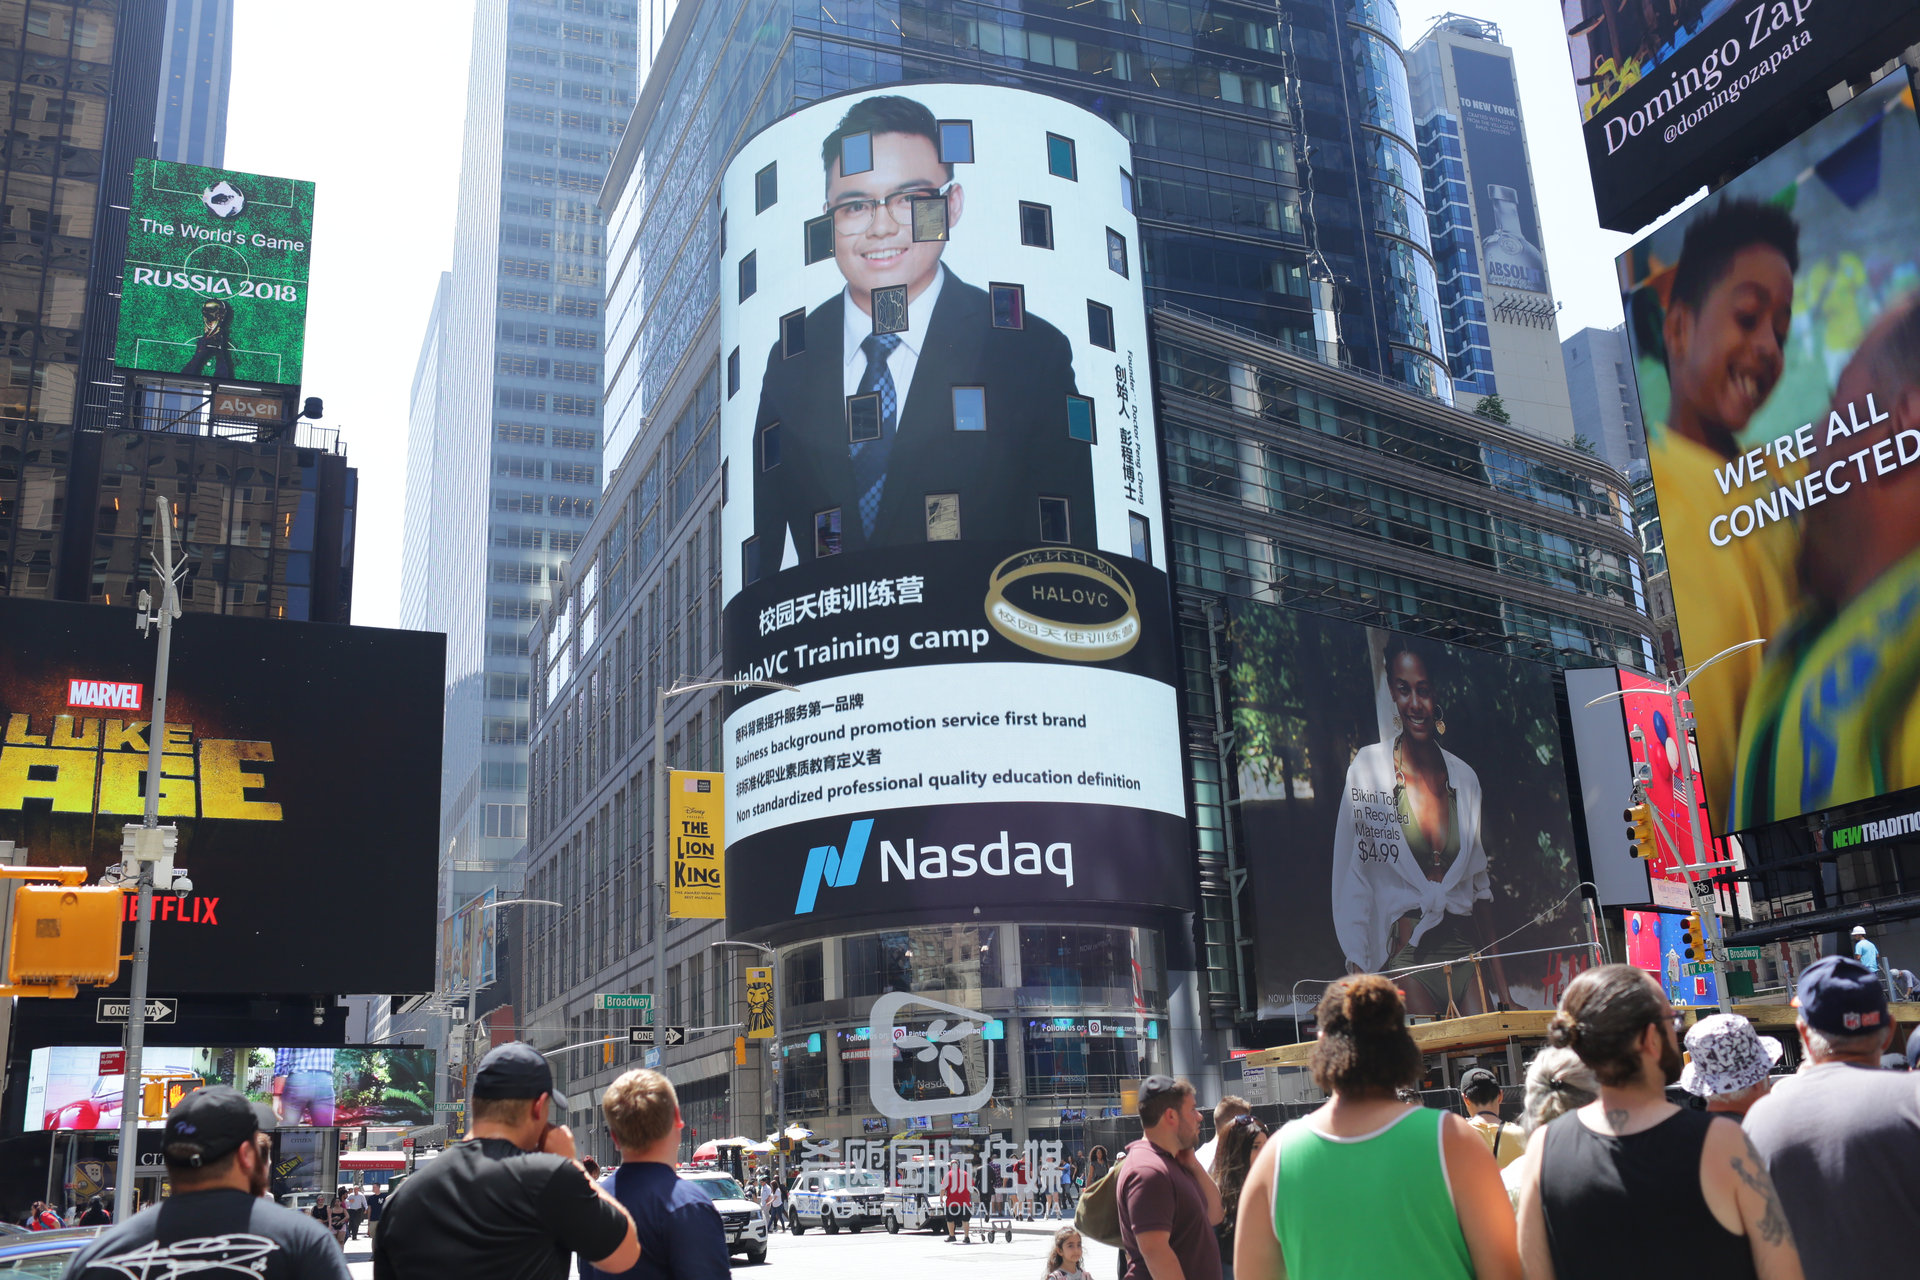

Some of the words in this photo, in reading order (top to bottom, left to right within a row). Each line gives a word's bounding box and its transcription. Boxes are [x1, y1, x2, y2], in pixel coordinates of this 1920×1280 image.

[1603, 38, 1740, 156] Domingo
[1664, 30, 1813, 143] @domingozapata
[1460, 97, 1471, 107] TO
[1473, 100, 1491, 112] NEW
[139, 218, 174, 235] The
[180, 223, 246, 245] World's
[251, 233, 305, 252] Game
[133, 267, 233, 295] RUSSIA
[238, 280, 297, 302] 2018
[1115, 364, 1131, 420] 创始人
[220, 398, 278, 417] Absen
[1131, 404, 1139, 441] Doctor
[1137, 472, 1145, 506] Cheng
[1713, 422, 1817, 495] WE'RE
[1826, 393, 1889, 447] ALL
[1709, 429, 1920, 547] CONNECTED
[759, 575, 925, 637] 校园天使训练营
[1032, 585, 1109, 607] HALOVC
[733, 650, 788, 695] HaloVC
[794, 631, 899, 669] Training
[909, 628, 989, 653] camp
[69, 681, 140, 708] MARVEL
[4, 713, 194, 753] LUKE
[735, 746, 769, 770] Business
[771, 724, 845, 754] background
[850, 715, 936, 741] promotion
[942, 712, 1000, 728] service
[1005, 711, 1038, 726] first
[1042, 712, 1087, 728] brand
[736, 807, 751, 824] Non
[752, 785, 823, 817] standardized
[827, 773, 923, 803] professional
[929, 769, 987, 790] quality
[992, 769, 1073, 785] education
[1077, 771, 1141, 791] definition
[1351, 788, 1379, 805] Bikini
[1380, 791, 1399, 807] Top
[684, 806, 705, 815] Disney
[1353, 805, 1363, 818] in
[1364, 806, 1411, 826] Recycled
[682, 821, 708, 834] THE
[1355, 822, 1400, 841] Materials
[677, 837, 715, 859] LION
[880, 831, 1074, 888] Nasdaq
[1358, 838, 1400, 864] $4.99
[674, 861, 720, 888] KING
[122, 895, 220, 926] ETFLIX
[1729, 949, 1758, 960] Broadway
[1690, 965, 1696, 973] W
[1699, 964, 1707, 972] 43
[109, 1005, 130, 1016] ONE
[606, 995, 650, 1009] Broadway
[1268, 994, 1285, 1003] NOW
[1295, 994, 1322, 1003] STORES
[636, 1032, 653, 1040] ONE
[665, 1032, 677, 1040] AY
[1042, 1024, 1066, 1032] Follow
[436, 1103, 462, 1111] BROADWAY
